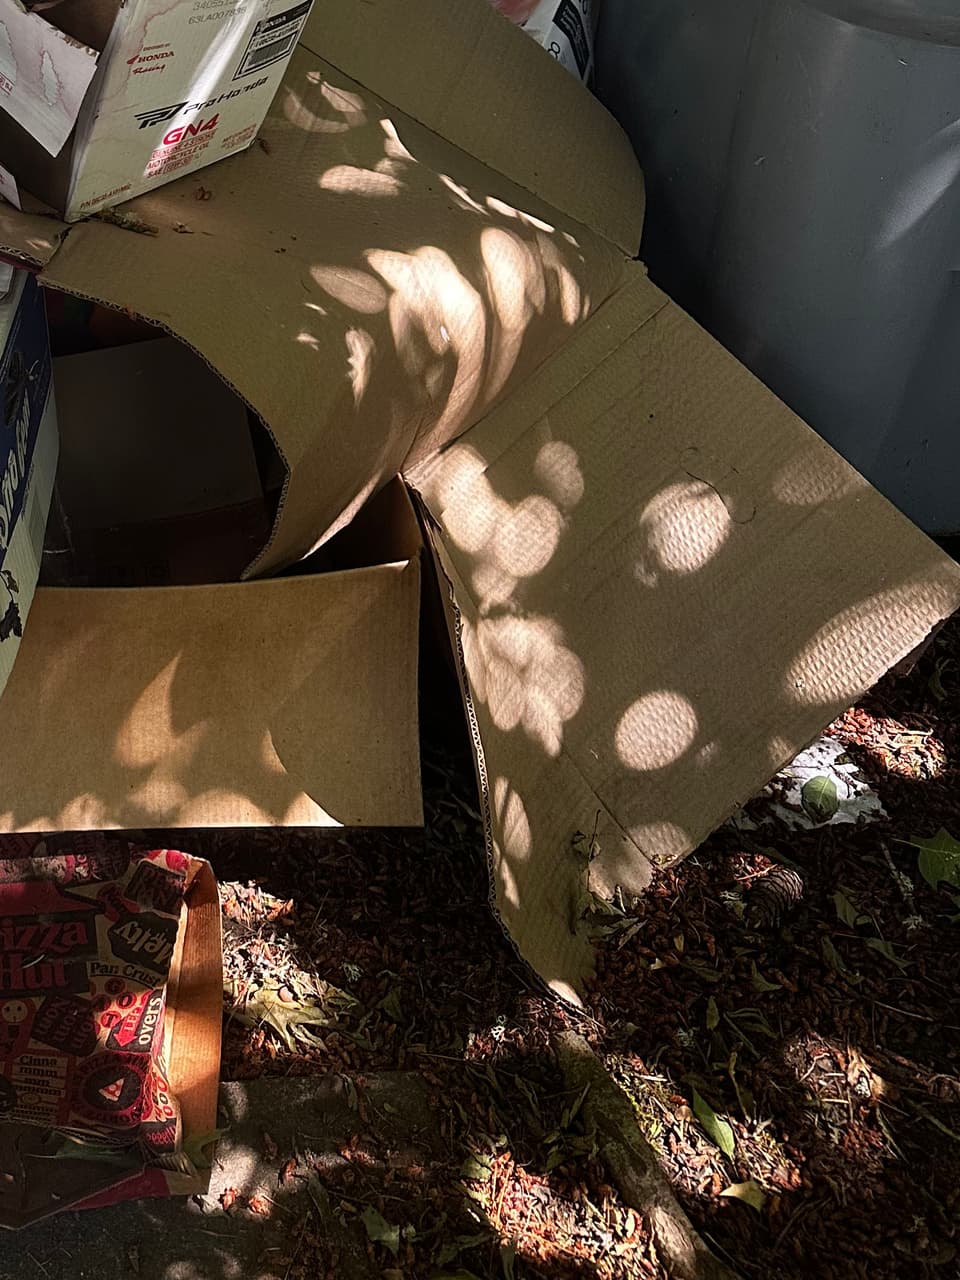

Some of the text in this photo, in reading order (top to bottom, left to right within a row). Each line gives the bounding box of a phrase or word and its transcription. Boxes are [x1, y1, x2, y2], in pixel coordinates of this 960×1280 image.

[138, 51, 175, 63] HONDA
[163, 113, 220, 146] GN4
[91, 962, 159, 988] Pan Crust
[138, 996, 162, 1045] overs
